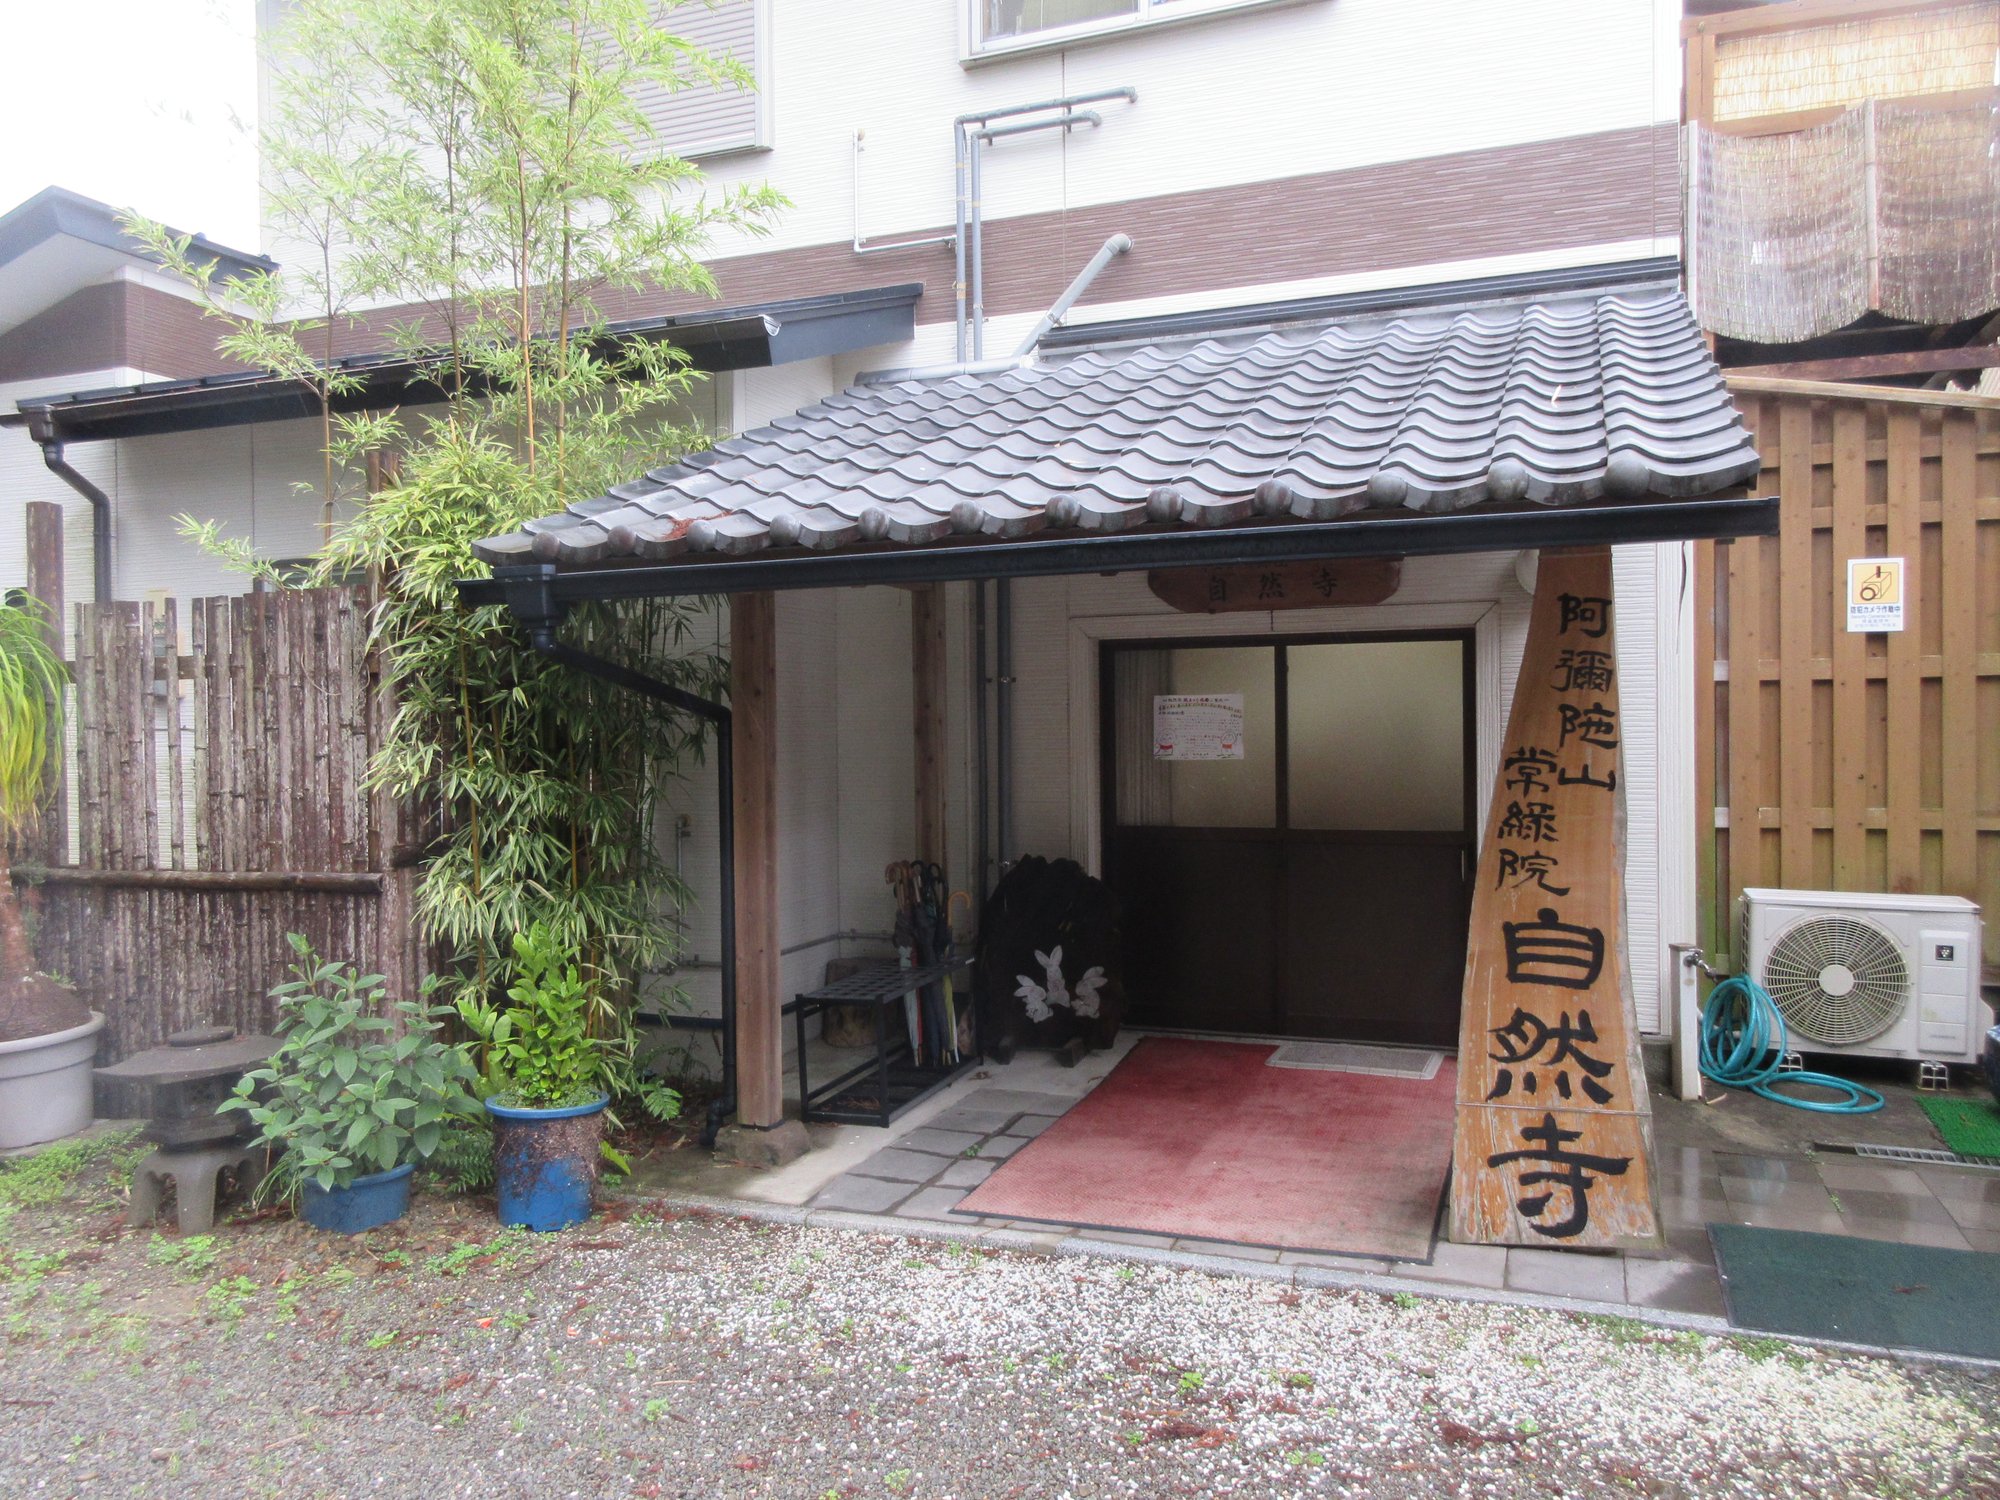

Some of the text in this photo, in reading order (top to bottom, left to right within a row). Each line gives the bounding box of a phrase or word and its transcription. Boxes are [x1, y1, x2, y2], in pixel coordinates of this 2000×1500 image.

[1208, 567, 1338, 602] 自然寺
[1485, 907, 1634, 1238] 自然寺
